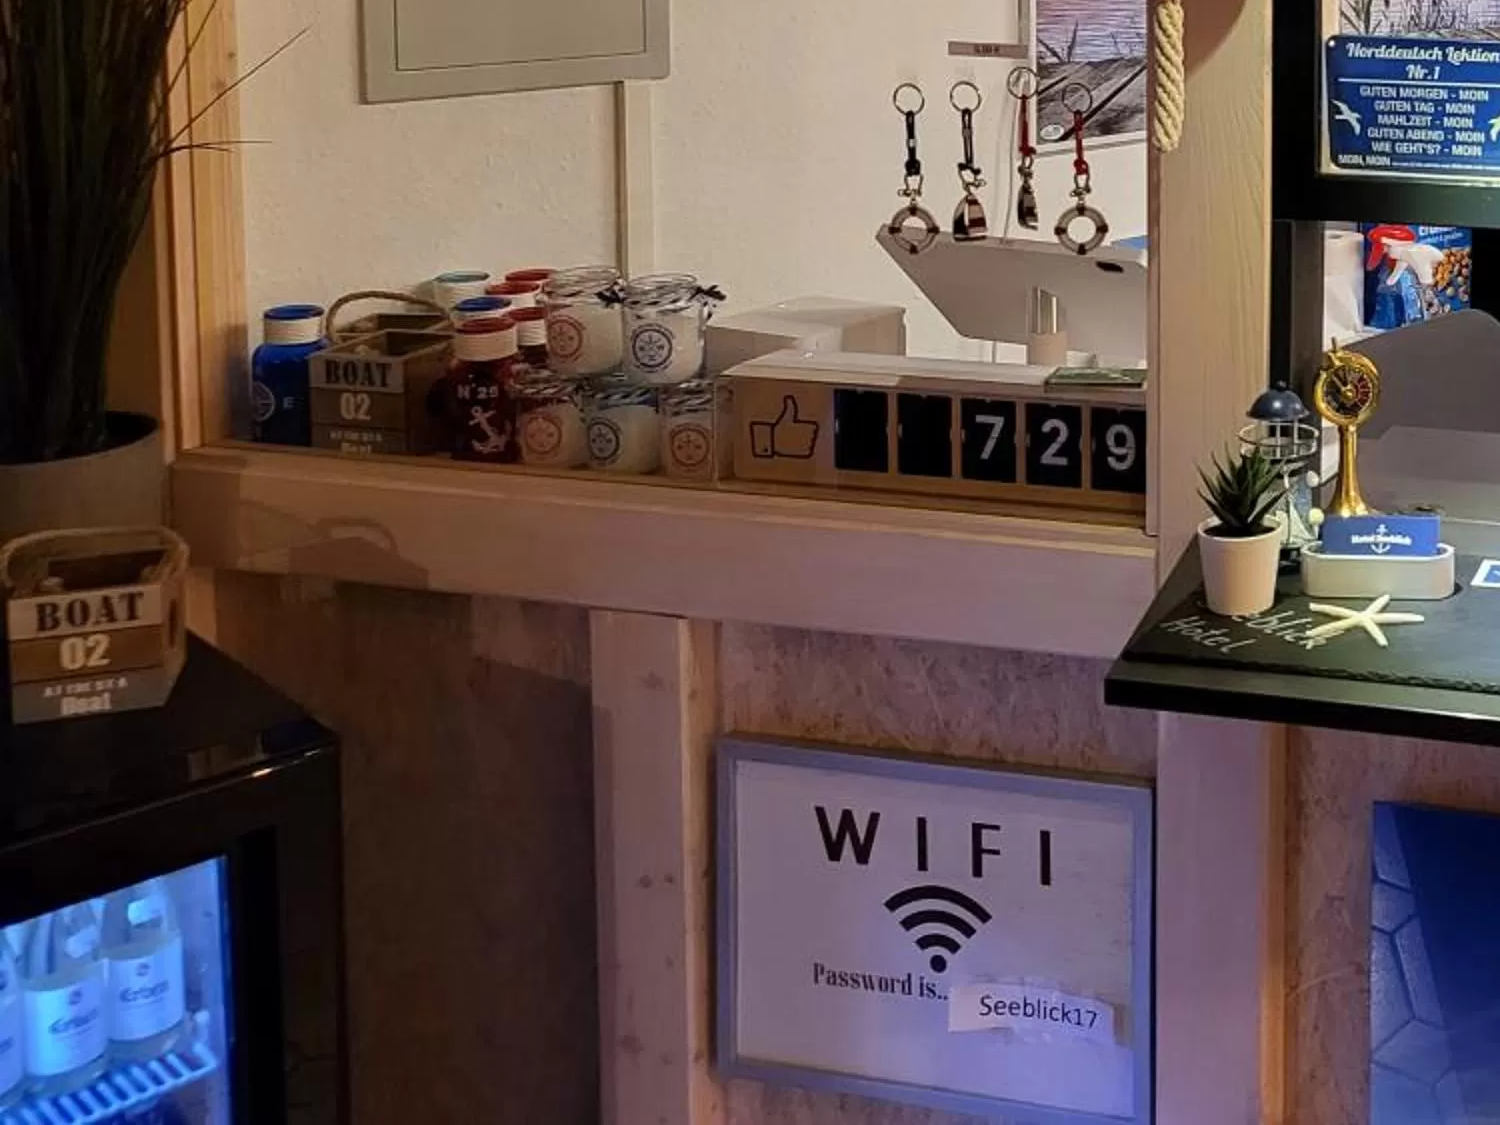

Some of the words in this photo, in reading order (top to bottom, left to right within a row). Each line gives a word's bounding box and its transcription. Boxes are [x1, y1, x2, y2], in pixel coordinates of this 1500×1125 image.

[1345, 42, 1443, 61] Norddeutsch
[1445, 45, 1500, 65] Lektion
[1360, 85, 1397, 99] GUTEN
[1399, 86, 1448, 100] MORGEN
[1459, 88, 1489, 101] MOIN
[1373, 100, 1411, 112] GUTEN
[1413, 101, 1435, 113] TAG
[1445, 103, 1475, 115] MOIN
[1367, 127, 1404, 140] GUTEN
[1405, 128, 1445, 141] ABEND
[1455, 130, 1485, 143] MOIN
[1377, 114, 1433, 127] MAHLZEIT
[1443, 116, 1473, 128] MOIN
[1366, 155, 1391, 166] MOIN
[1371, 141, 1392, 153] WIE
[1395, 142, 1441, 155] GEHT'S?
[1452, 144, 1482, 156] MOIN
[325, 359, 393, 388] BOAT
[340, 392, 372, 421] 02
[35, 591, 145, 632] BOAT
[1159, 616, 1257, 654] Hotel
[59, 633, 112, 670] 02
[814, 805, 1051, 886] WIFI
[813, 961, 912, 996] Password
[979, 994, 1098, 1029] Seeblick17
